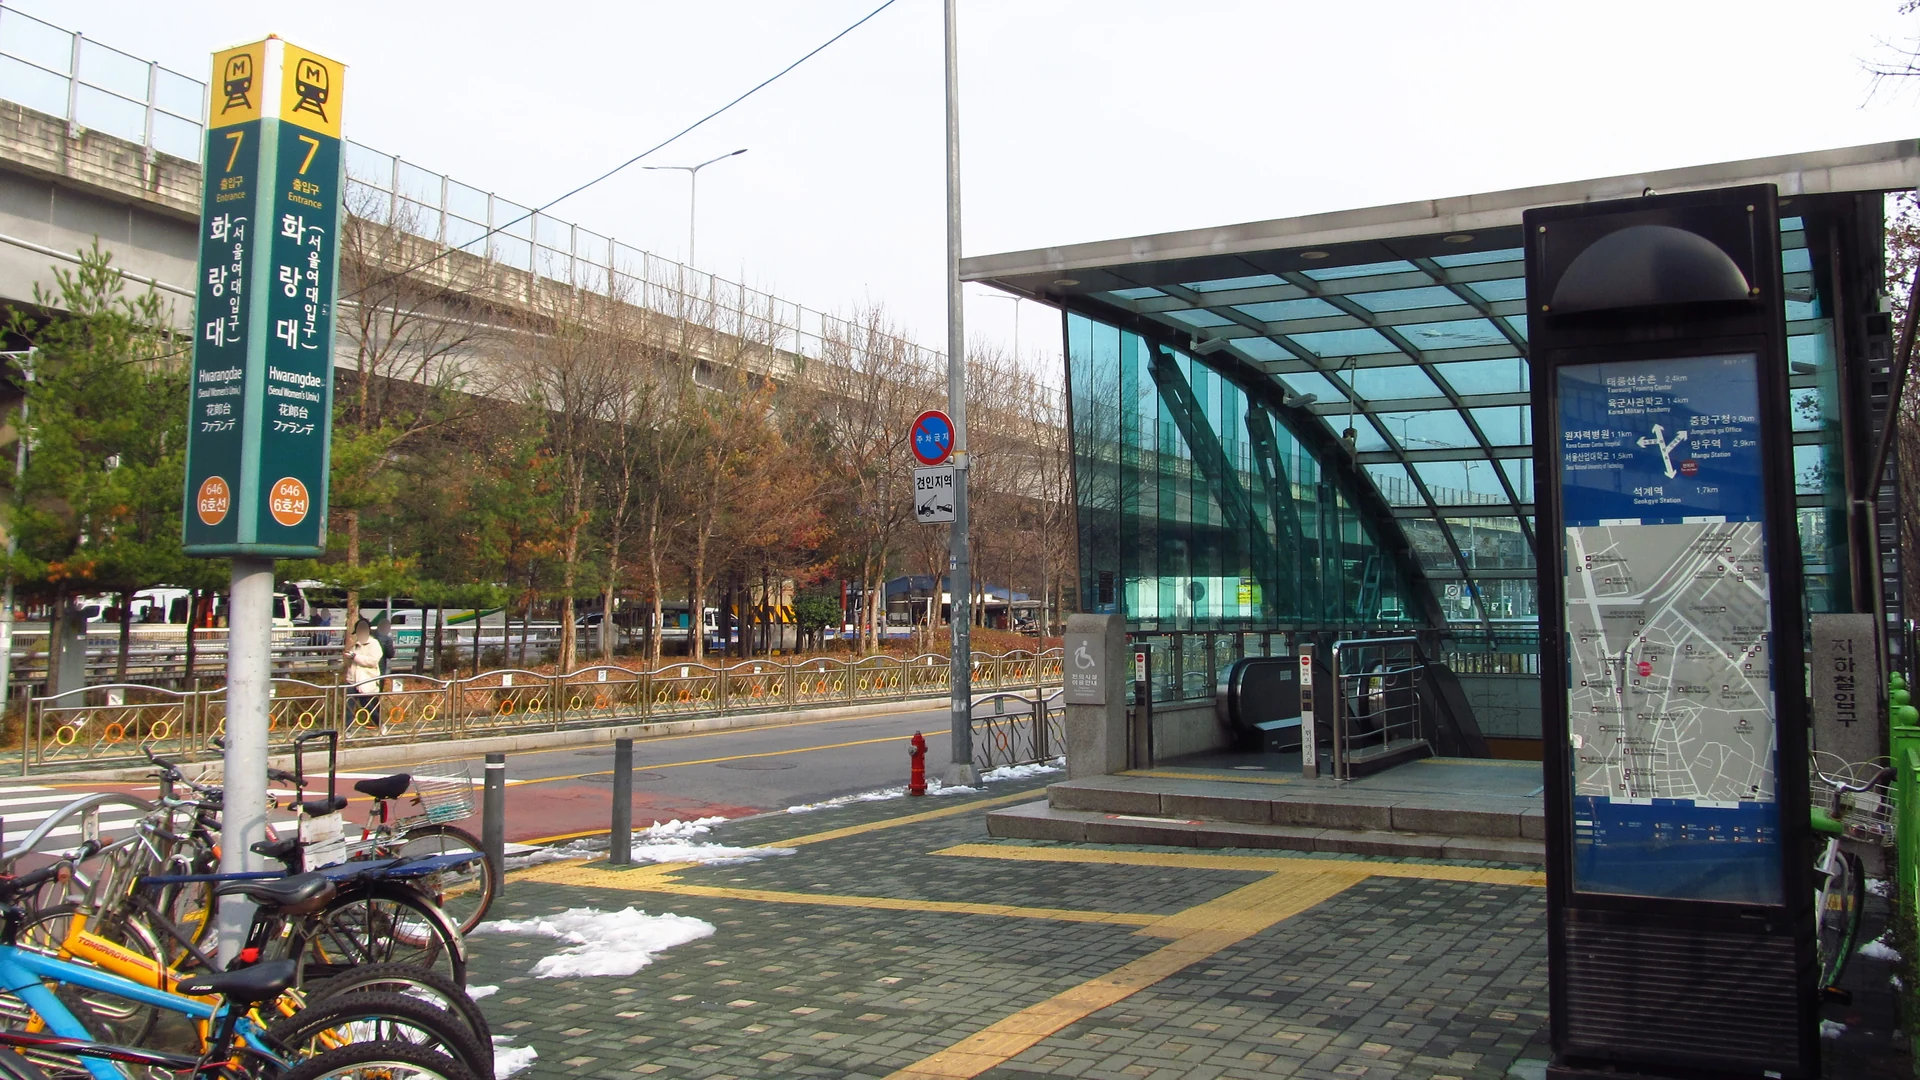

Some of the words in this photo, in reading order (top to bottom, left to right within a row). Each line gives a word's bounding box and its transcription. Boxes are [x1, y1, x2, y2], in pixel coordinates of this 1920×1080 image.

[232, 61, 245, 75] M
[305, 65, 320, 83] M
[225, 130, 245, 173] 7
[298, 134, 320, 175] 7
[219, 175, 243, 191] 출입구
[292, 178, 320, 196] 출입구
[216, 190, 246, 203] Entrance
[288, 192, 322, 209] Entrance
[206, 213, 231, 347] 화랑대
[227, 216, 248, 343] (서울여대입구)
[276, 213, 306, 350] 화랑대
[301, 225, 325, 350] (서울여대입구)
[199, 366, 242, 384] Hwarangdae
[269, 366, 321, 388] Hwarangdae
[1665, 374, 1688, 383] 2.4km
[268, 385, 283, 396] (Seoul
[283, 387, 305, 399] Women's
[206, 402, 231, 415] 花郎台
[1608, 397, 1664, 408] 육군사관학교
[1667, 397, 1689, 405] 1.4km
[1646, 405, 1671, 414] Academy
[278, 403, 308, 419] 花郎台
[201, 418, 236, 432] ファランデ
[273, 420, 315, 435] ファランデ
[1690, 414, 1731, 426] 중랑구청
[1732, 415, 1755, 423] 2.0km
[916, 432, 949, 443] 주차금지
[1564, 430, 1610, 441] 원자력병원
[1611, 430, 1633, 438] 1.1km
[1691, 439, 1721, 450] 망우역
[1733, 439, 1756, 448] 2.9km
[1565, 452, 1609, 463] 서울산업대학교
[1612, 452, 1634, 460] 1.5km
[1710, 450, 1731, 458] Station
[206, 483, 222, 495] 646
[280, 483, 300, 496] 646
[916, 474, 952, 490] 견인지역
[1633, 486, 1663, 497] 석계역
[1696, 486, 1719, 495] 1.7km
[200, 497, 227, 513] 6호선
[273, 498, 305, 514] 6호선
[1659, 496, 1681, 504] Station
[1831, 638, 1858, 728] 지하철입구
[79, 936, 131, 962] TOMORROW
